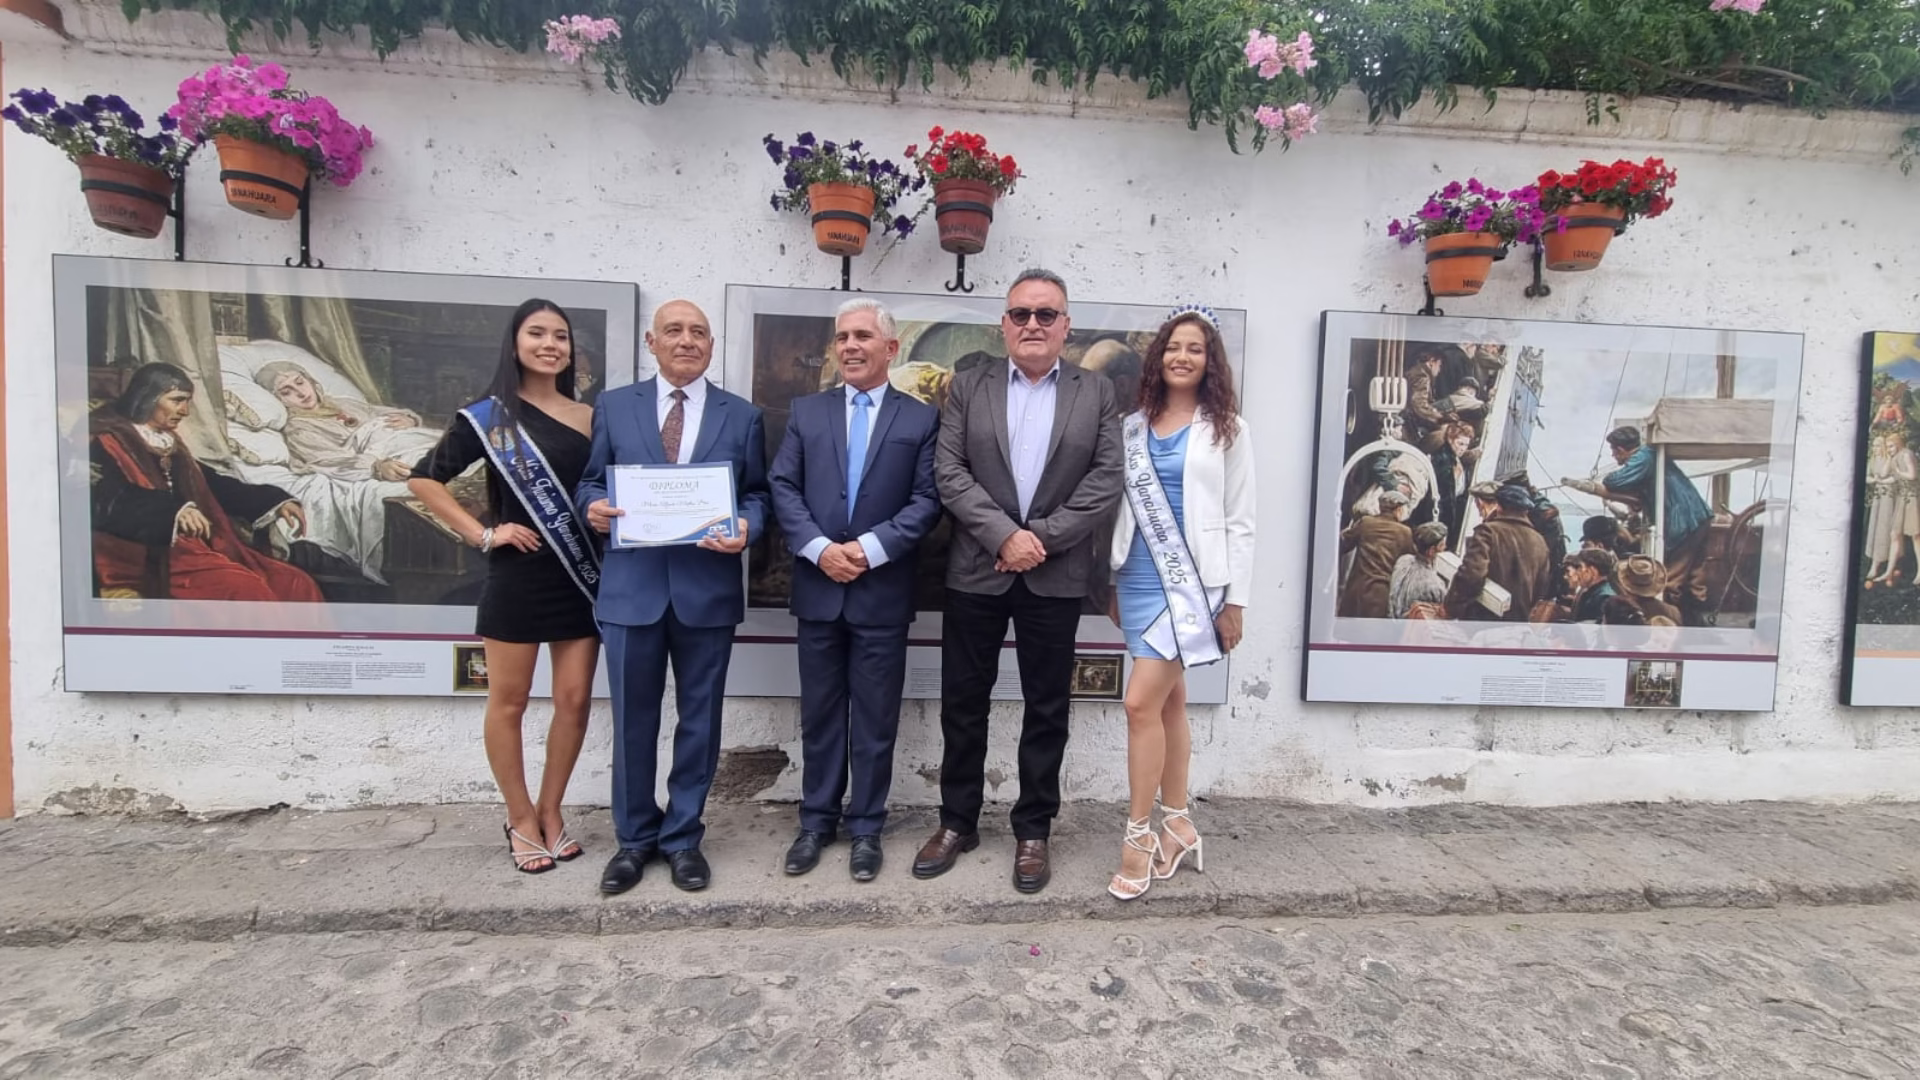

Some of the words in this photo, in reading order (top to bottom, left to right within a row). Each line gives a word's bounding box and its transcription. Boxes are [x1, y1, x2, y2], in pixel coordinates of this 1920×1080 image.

[1127, 443, 1145, 470] Miss
[648, 480, 700, 491] DIPLOMA
[1126, 472, 1169, 544] Yanahuara
[578, 561, 600, 584] 2025
[1163, 552, 1187, 585] 2025
